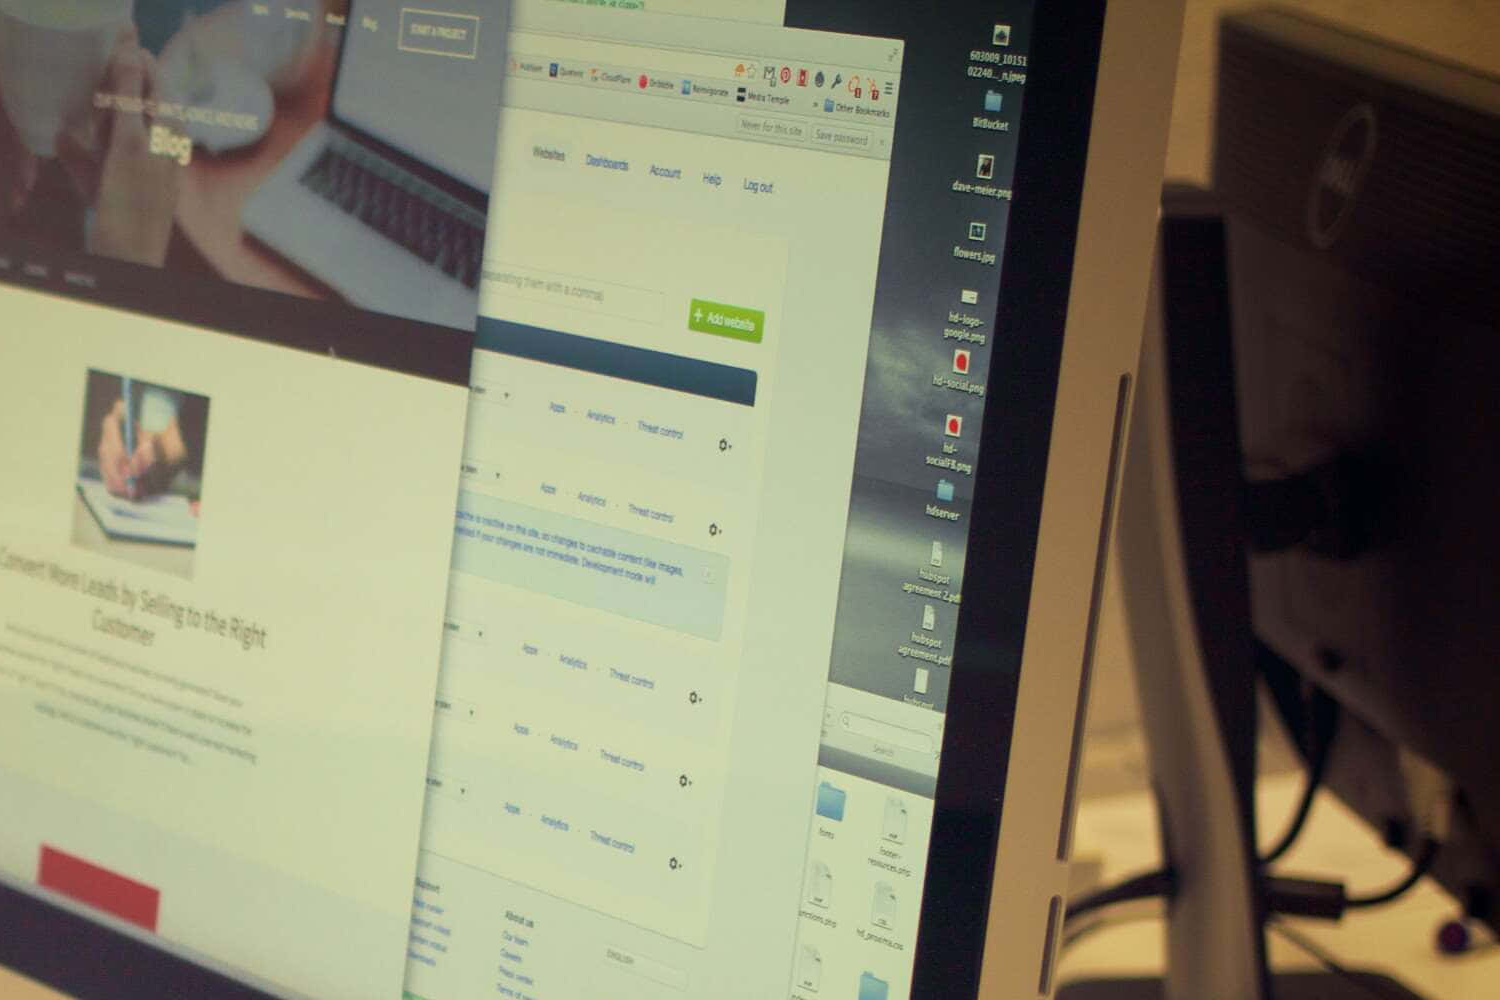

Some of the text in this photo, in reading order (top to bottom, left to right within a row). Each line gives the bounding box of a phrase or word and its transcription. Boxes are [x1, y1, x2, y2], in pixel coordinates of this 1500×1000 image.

[748, 92, 790, 106] Media Temple
[836, 102, 890, 119] Other Bookmarks
[741, 118, 802, 136] Never for this site
[973, 118, 1010, 131] BitBucket
[151, 125, 192, 166] Blog
[816, 129, 868, 147] Save password
[533, 146, 565, 162] Websites
[586, 154, 629, 171] Dashboards
[650, 164, 682, 180] Account
[703, 172, 722, 187] Help
[744, 177, 773, 194] Log out
[952, 180, 1012, 200] dave-meier.png
[954, 247, 996, 264] flowers.jpg
[707, 311, 755, 332] Add website
[944, 328, 986, 345] google.png
[932, 376, 985, 396] hd-social.png
[638, 420, 684, 440] Threat control
[919, 569, 951, 586] hubspot
[902, 582, 942, 601] agreement
[82, 575, 118, 602] Leads
[121, 584, 137, 612] by
[140, 590, 185, 629] Selling
[186, 607, 200, 629] to
[204, 611, 227, 637] the
[230, 616, 267, 650] Right
[92, 608, 155, 647] Customer
[911, 632, 943, 650] hubspot
